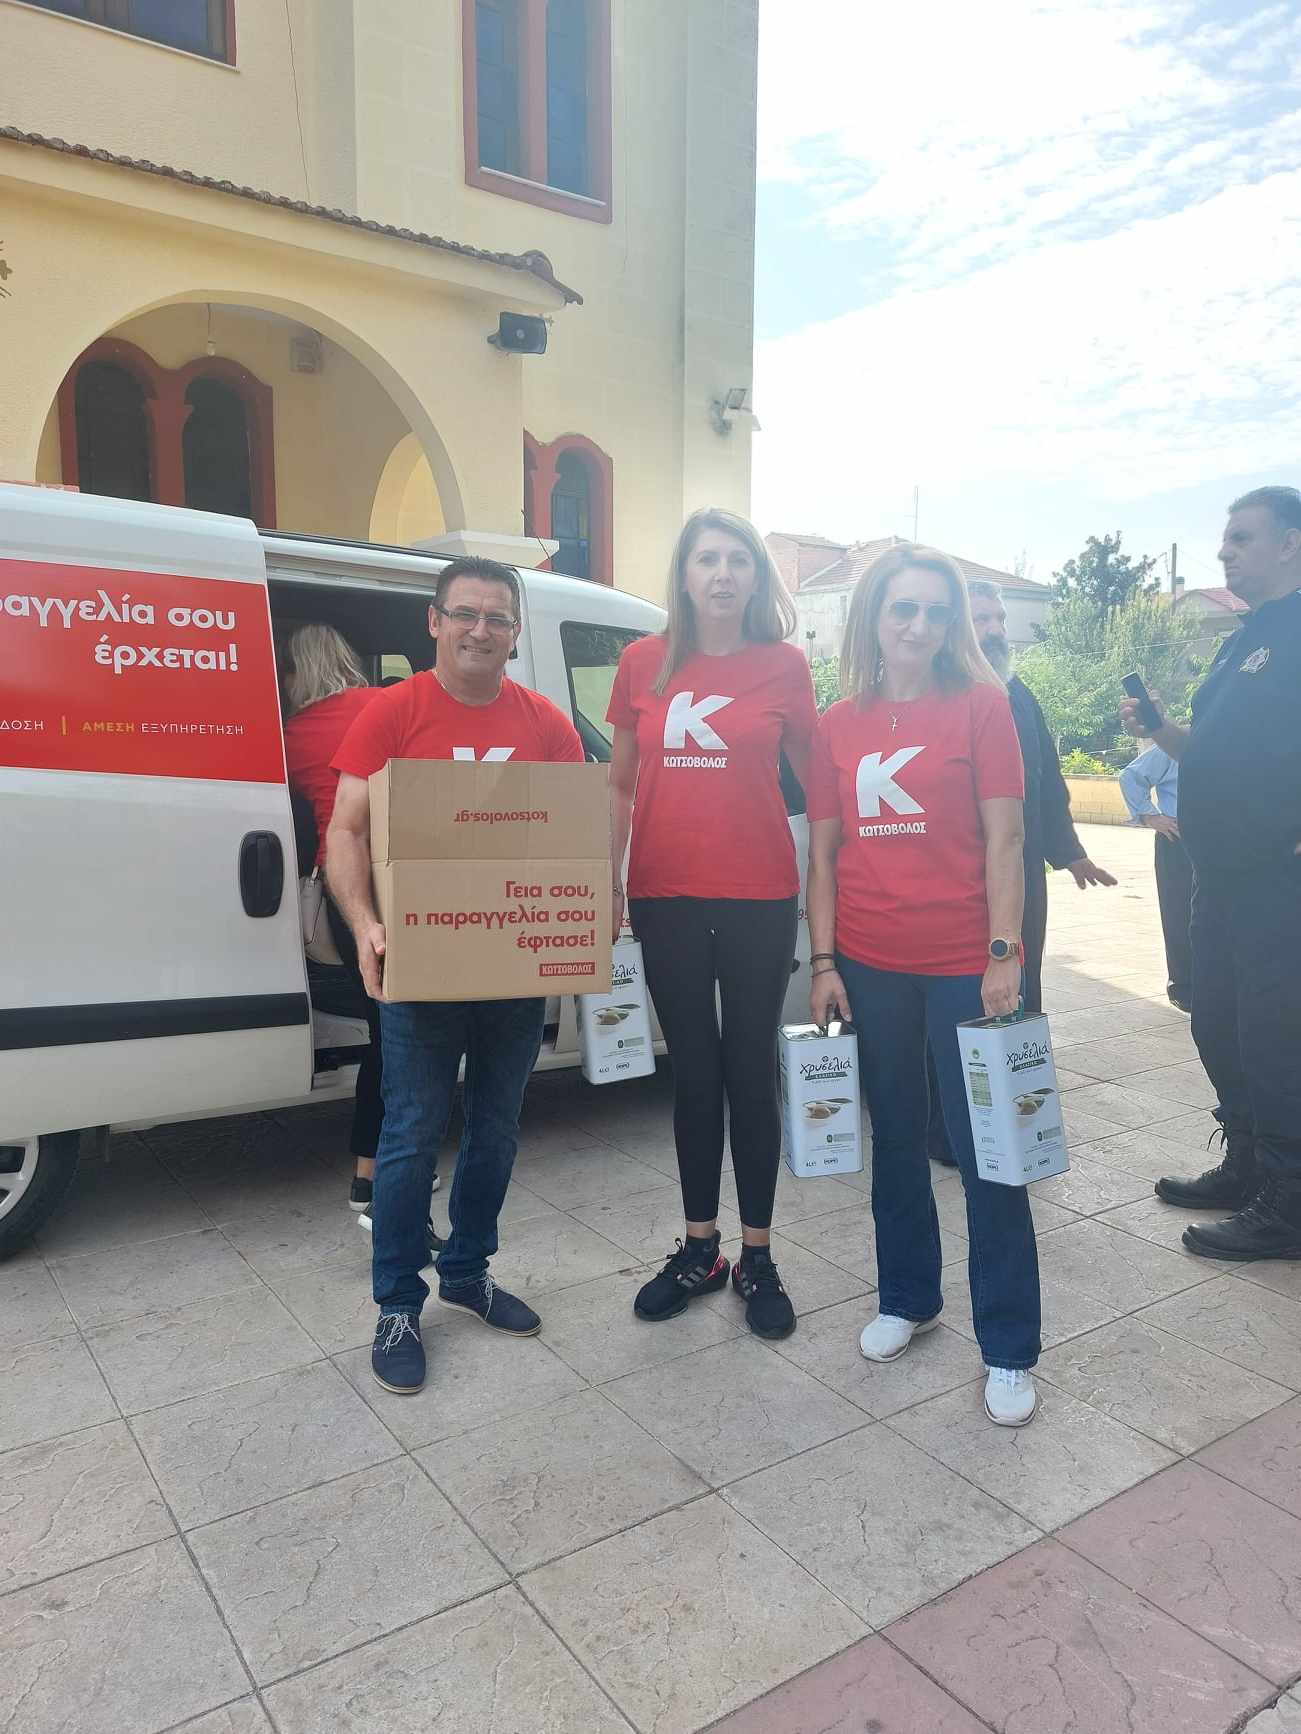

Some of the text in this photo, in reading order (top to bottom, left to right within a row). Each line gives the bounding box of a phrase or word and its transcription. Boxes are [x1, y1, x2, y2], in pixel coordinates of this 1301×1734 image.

[0, 589, 236, 631] αγγελία σου
[95, 633, 239, 675] έρχεται!
[0, 719, 44, 731] ΔΟΣΗ
[82, 721, 244, 736] ΑΜΕΣΗ ΕΞΥΠΗΡΕΤΗΣΗ
[663, 755, 728, 769] ΚΩΤΣΟΒΟΛΟΣ
[454, 810, 548, 825] kotsovolos.gr
[858, 822, 927, 838] ΚΩΤΣΟΒΟΛΟΣ
[505, 880, 595, 900] Γεια σου,
[405, 904, 596, 930] η παραγγελία σου
[516, 929, 596, 953] έφτασε!
